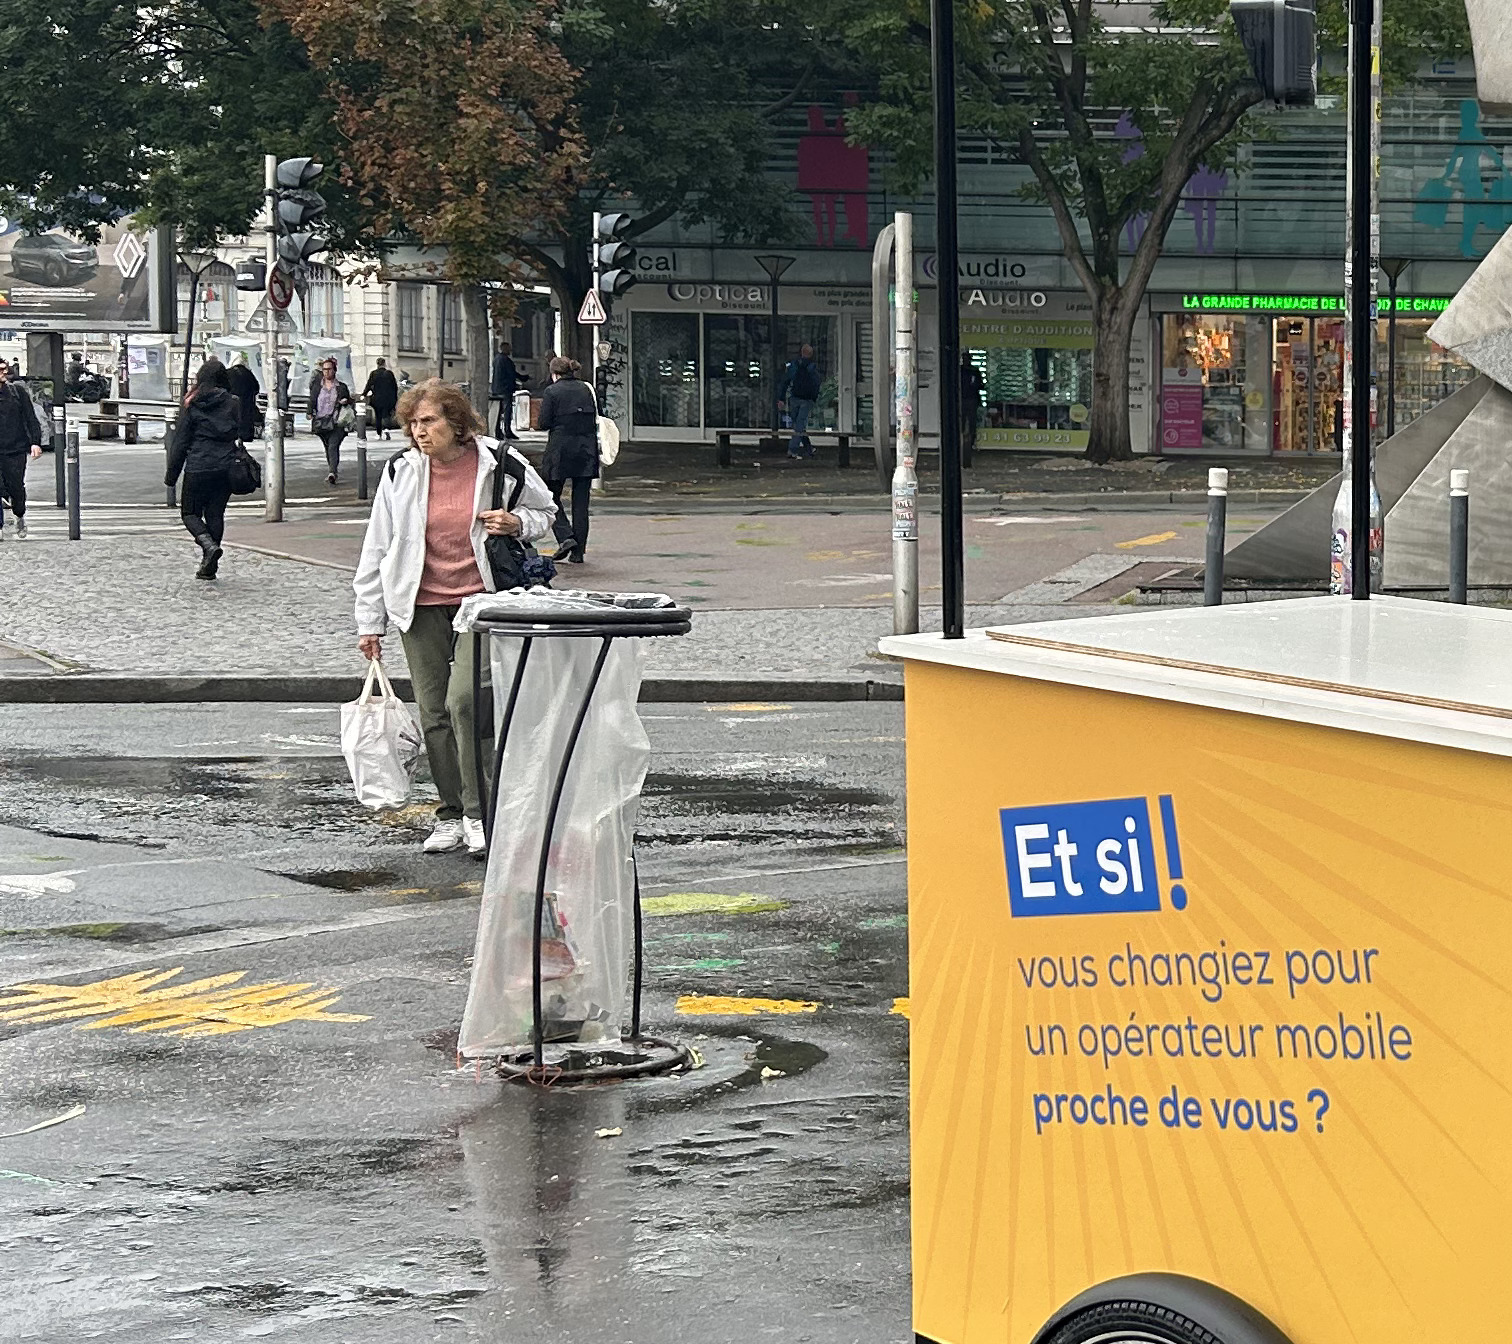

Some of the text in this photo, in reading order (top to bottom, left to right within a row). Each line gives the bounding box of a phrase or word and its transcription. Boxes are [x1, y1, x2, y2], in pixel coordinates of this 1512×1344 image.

[967, 289, 1047, 307] Audio
[1183, 295, 1200, 308] LA
[1202, 295, 1250, 309] GRANDE
[1252, 296, 1319, 310] PHARMACIE
[1321, 297, 1337, 310] DE
[1395, 298, 1412, 311] DE
[1413, 298, 1452, 311] CHAVA
[960, 323, 1008, 335] ENTRE
[1014, 822, 1084, 898] Et
[1017, 939, 1379, 1002] vous changiez pour
[1025, 1010, 1414, 1069] un opérateur mobile
[1033, 1083, 1149, 1134] proche
[1159, 1086, 1202, 1129] de
[1211, 1097, 1299, 1133] vous
